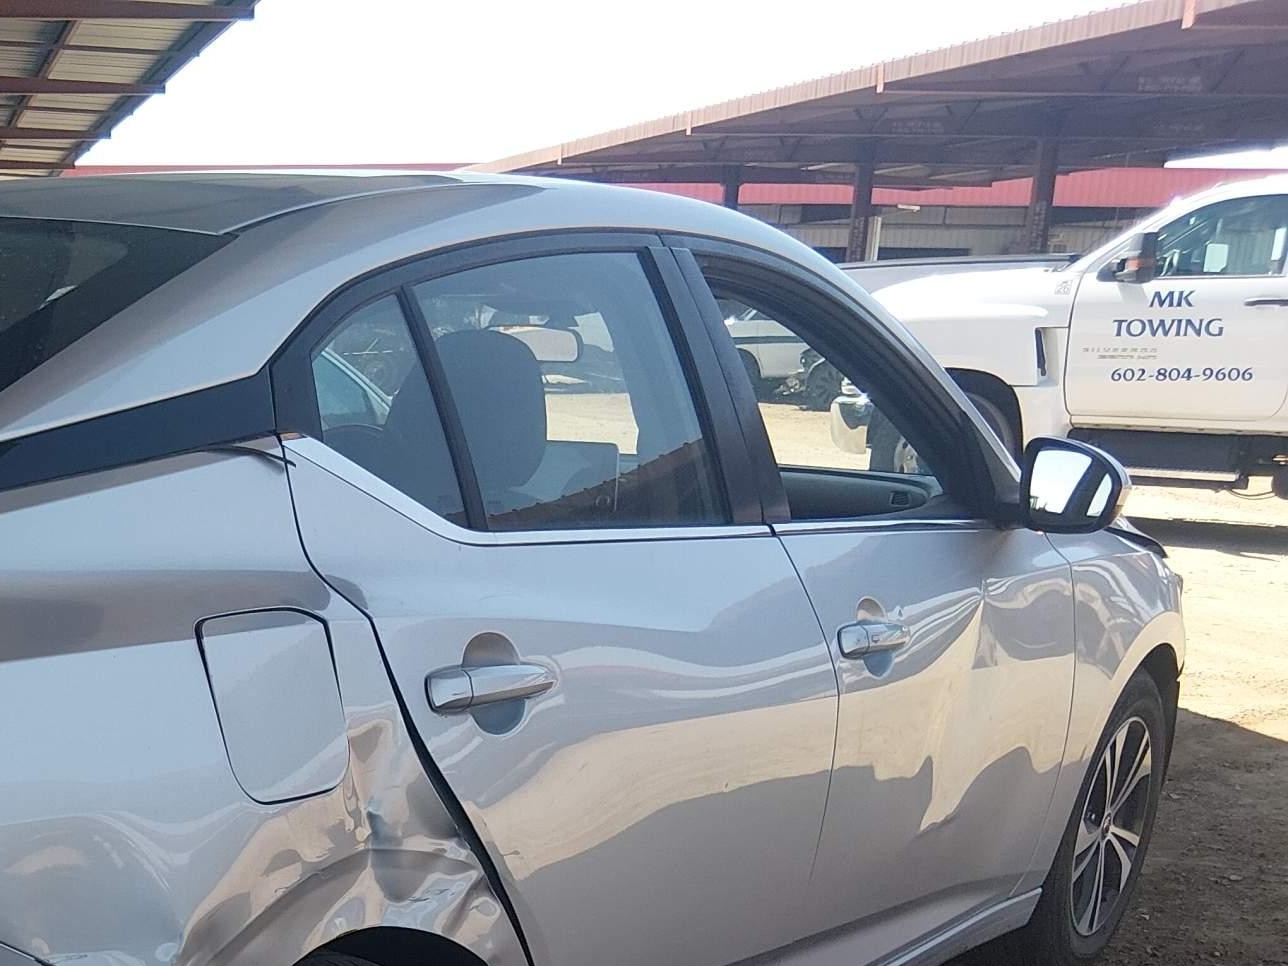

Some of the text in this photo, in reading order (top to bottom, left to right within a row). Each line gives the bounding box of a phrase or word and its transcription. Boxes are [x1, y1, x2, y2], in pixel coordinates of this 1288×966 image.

[1149, 290, 1196, 308] MK
[1112, 318, 1224, 337] TOWING
[1111, 367, 1253, 382] 602-804-9606
